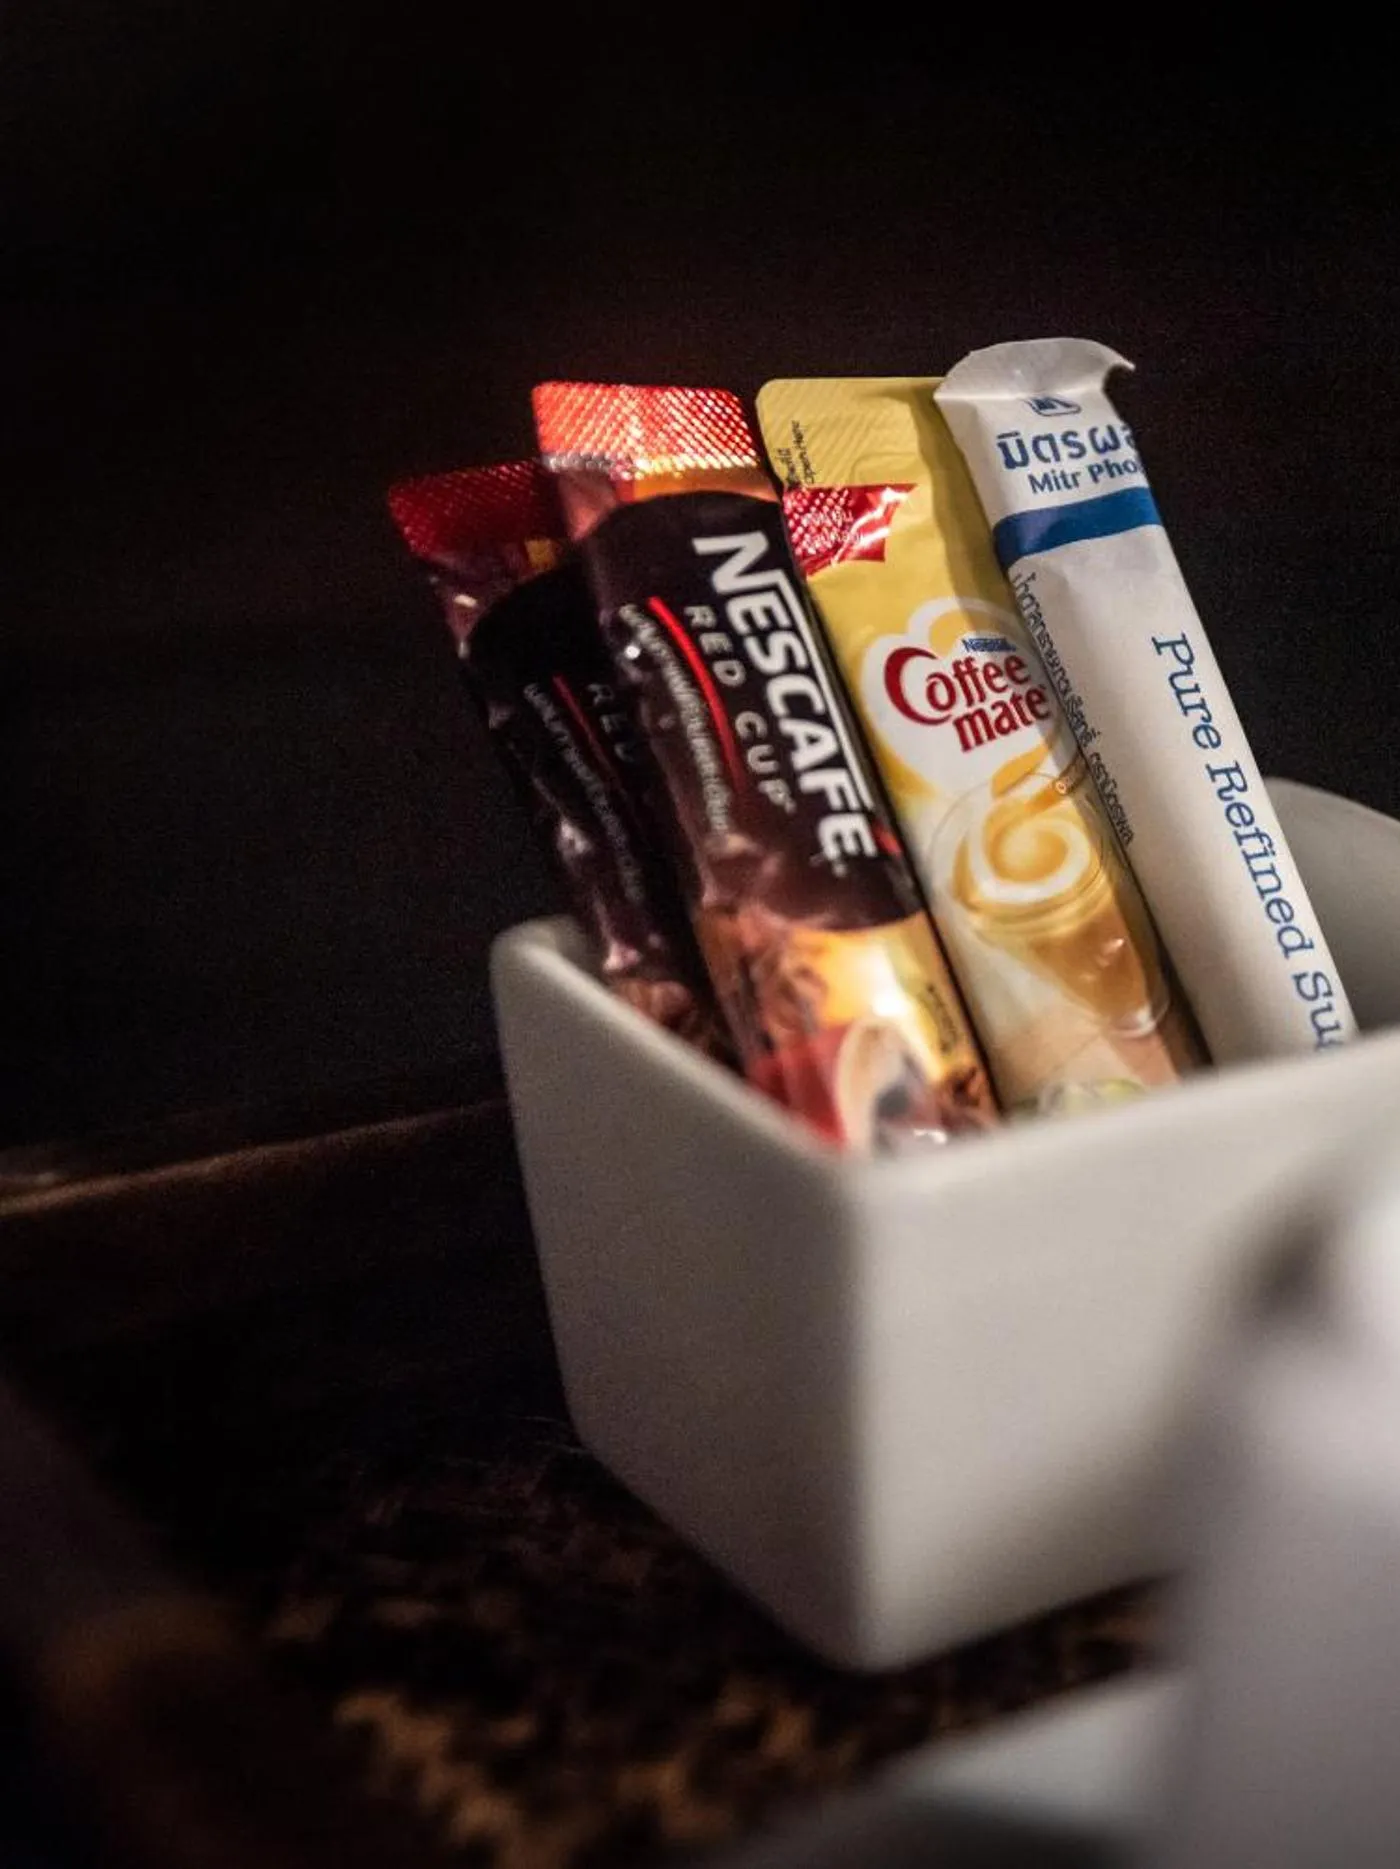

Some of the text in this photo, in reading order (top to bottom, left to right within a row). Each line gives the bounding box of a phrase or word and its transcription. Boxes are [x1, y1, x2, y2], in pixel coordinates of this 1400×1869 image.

[1027, 457, 1144, 495] Mitr Pho
[685, 605, 789, 807] RED CUP
[884, 646, 1031, 726] Coffee
[952, 685, 1052, 753] mate
[1151, 632, 1223, 751] Pure
[1206, 760, 1316, 960] Refined
